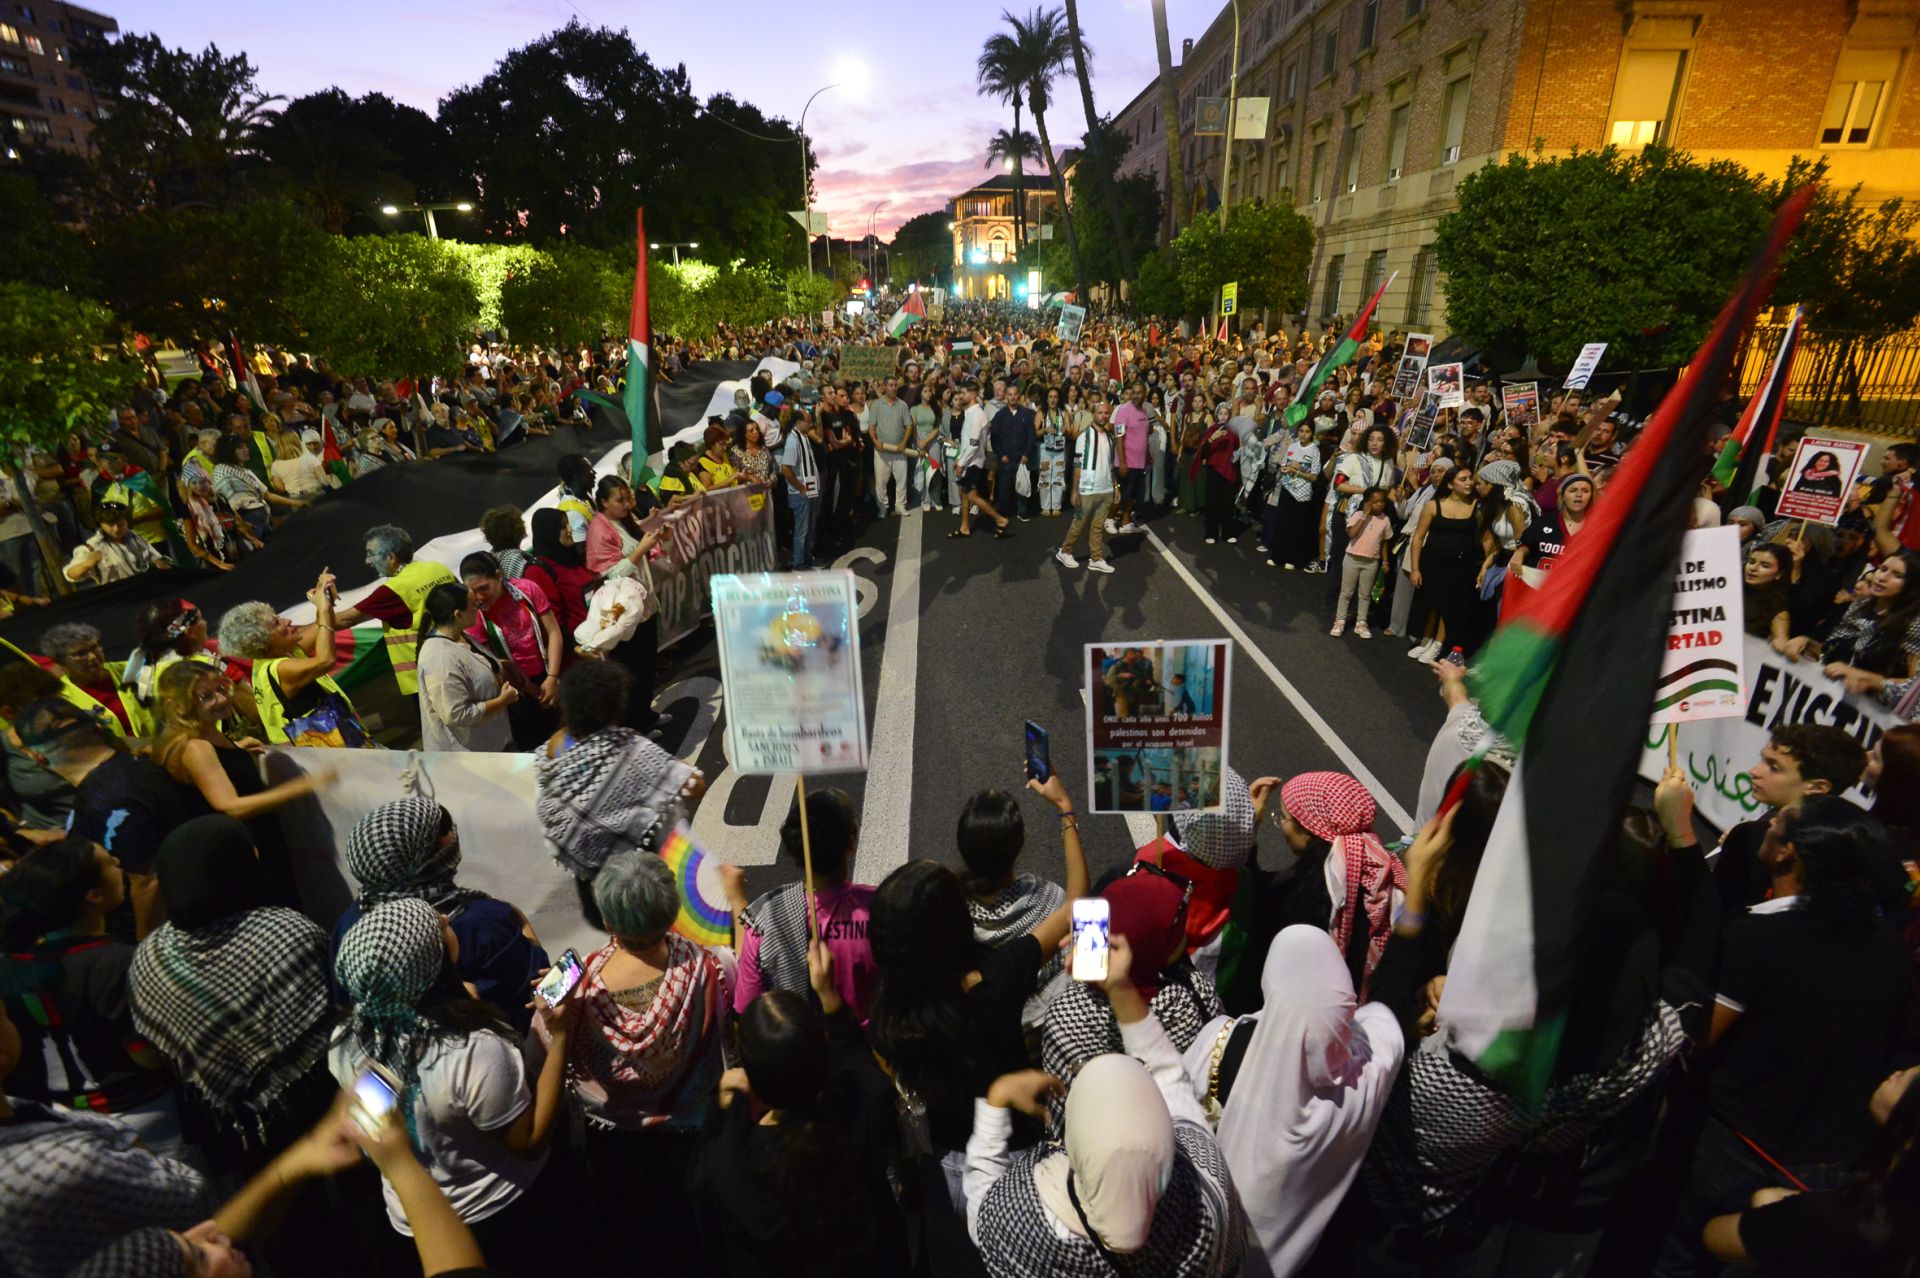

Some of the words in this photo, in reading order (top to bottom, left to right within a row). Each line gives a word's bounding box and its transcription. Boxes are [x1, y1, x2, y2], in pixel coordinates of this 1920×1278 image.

[1685, 560, 1705, 574] DE
[1669, 606, 1726, 627] STINA
[1667, 630, 1723, 650] RTAD
[1173, 712, 1188, 723] 700
[778, 720, 843, 742] bombardeos
[1110, 728, 1148, 740] palestinos
[1151, 729, 1166, 738] son
[1169, 726, 1207, 738] detenidos
[1122, 741, 1134, 749] por
[1177, 738, 1194, 748] Israel
